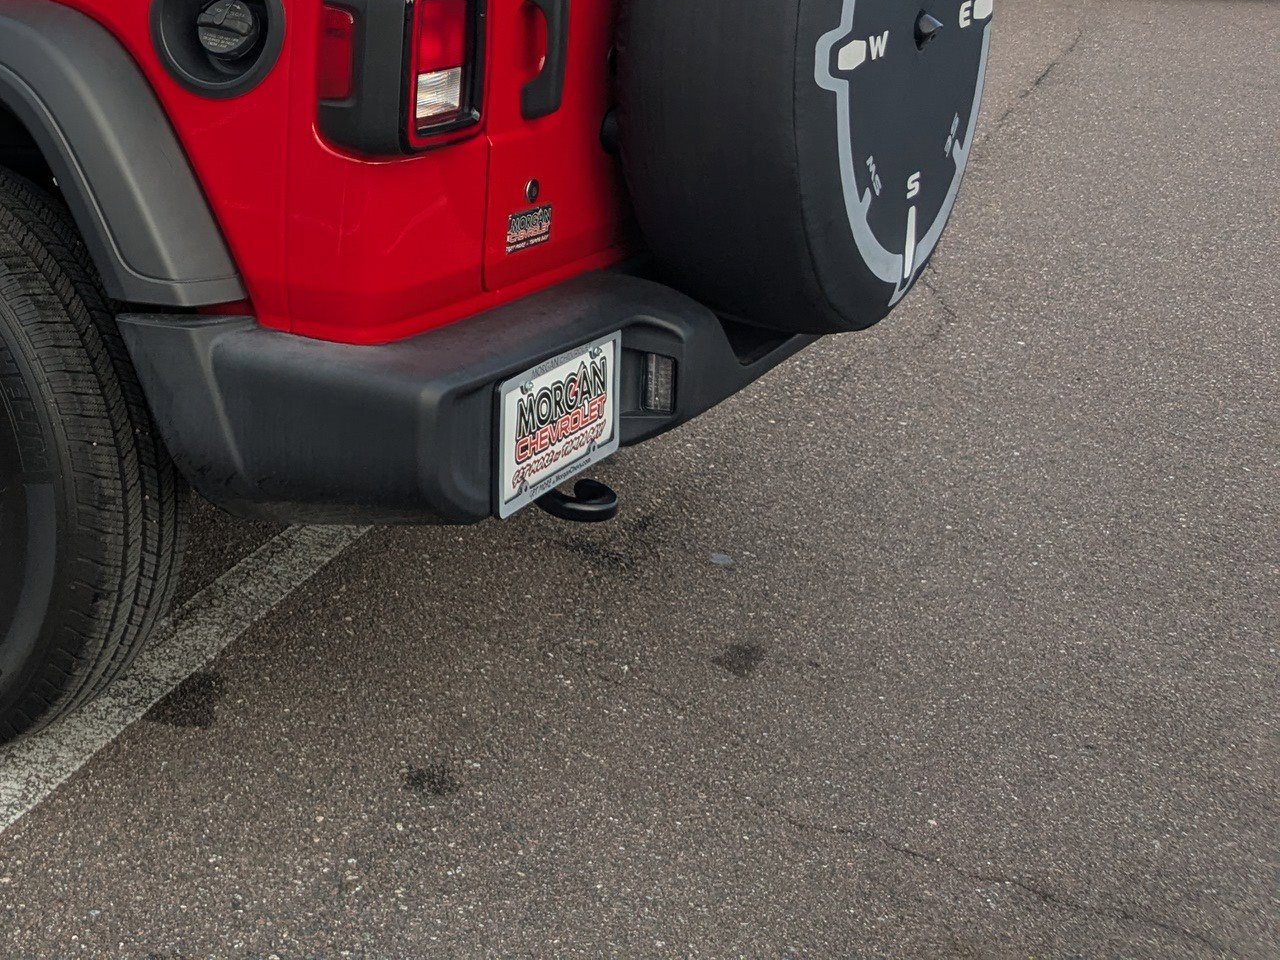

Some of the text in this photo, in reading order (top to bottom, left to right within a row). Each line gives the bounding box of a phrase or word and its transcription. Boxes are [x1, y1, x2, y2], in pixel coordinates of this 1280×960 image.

[958, 0, 972, 29] E
[869, 30, 889, 60] W
[906, 171, 920, 199] S
[510, 209, 551, 233] MORGAN
[516, 356, 607, 440] MORGAN
[514, 393, 607, 465] CHEVROLET
